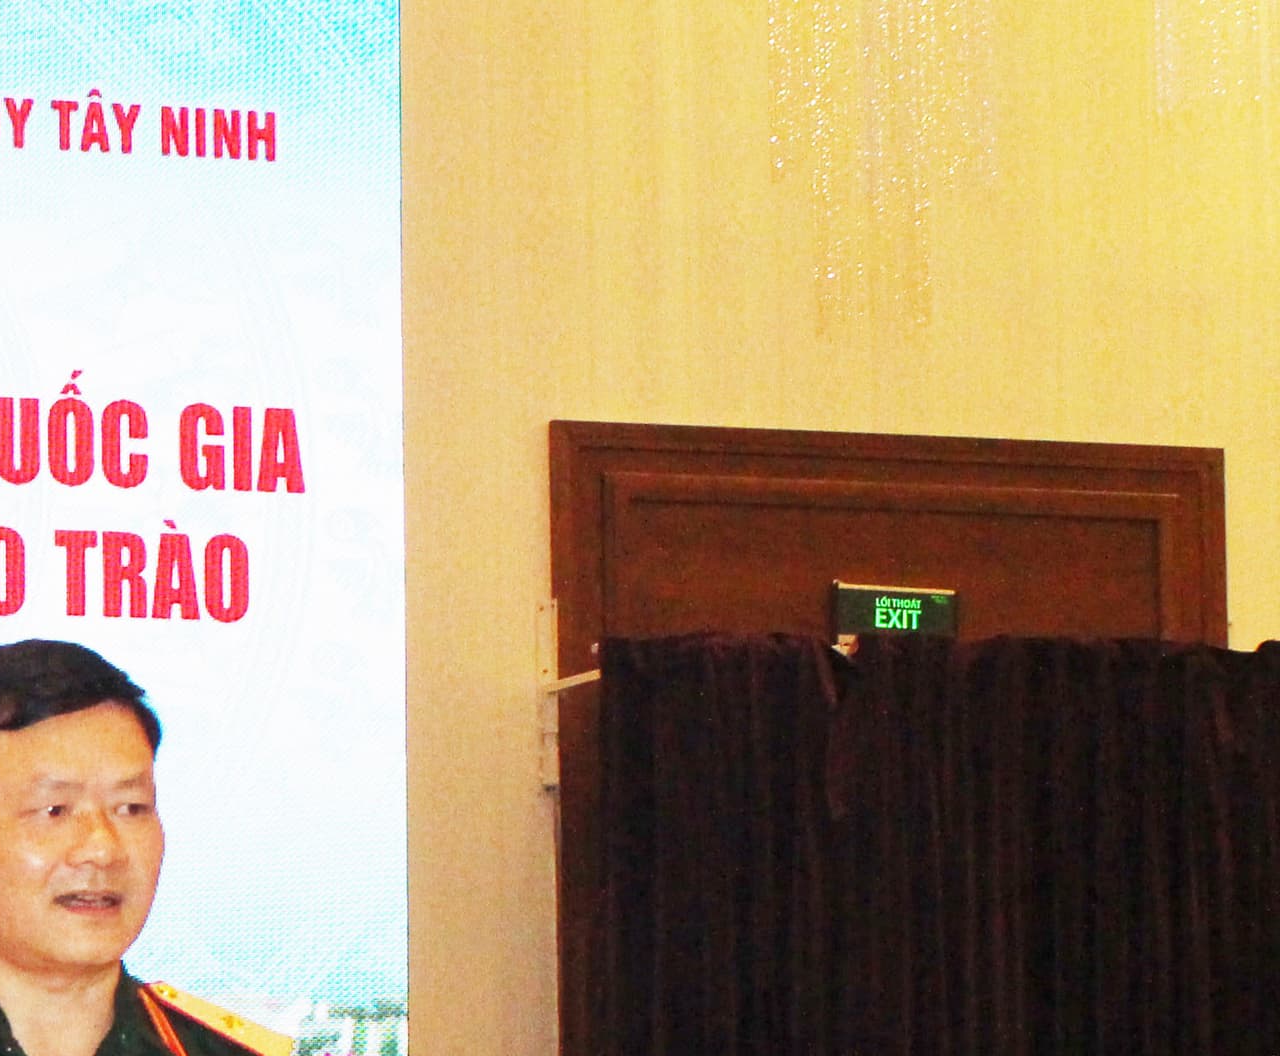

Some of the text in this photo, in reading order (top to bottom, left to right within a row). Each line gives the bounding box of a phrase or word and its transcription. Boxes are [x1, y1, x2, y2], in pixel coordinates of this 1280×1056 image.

[52, 88, 141, 154] TÂY
[161, 106, 276, 162] NINH
[179, 402, 305, 494] GIA
[55, 520, 249, 623] TRÀO
[891, 598, 921, 609] THOÁT
[875, 608, 922, 629] EXIT
